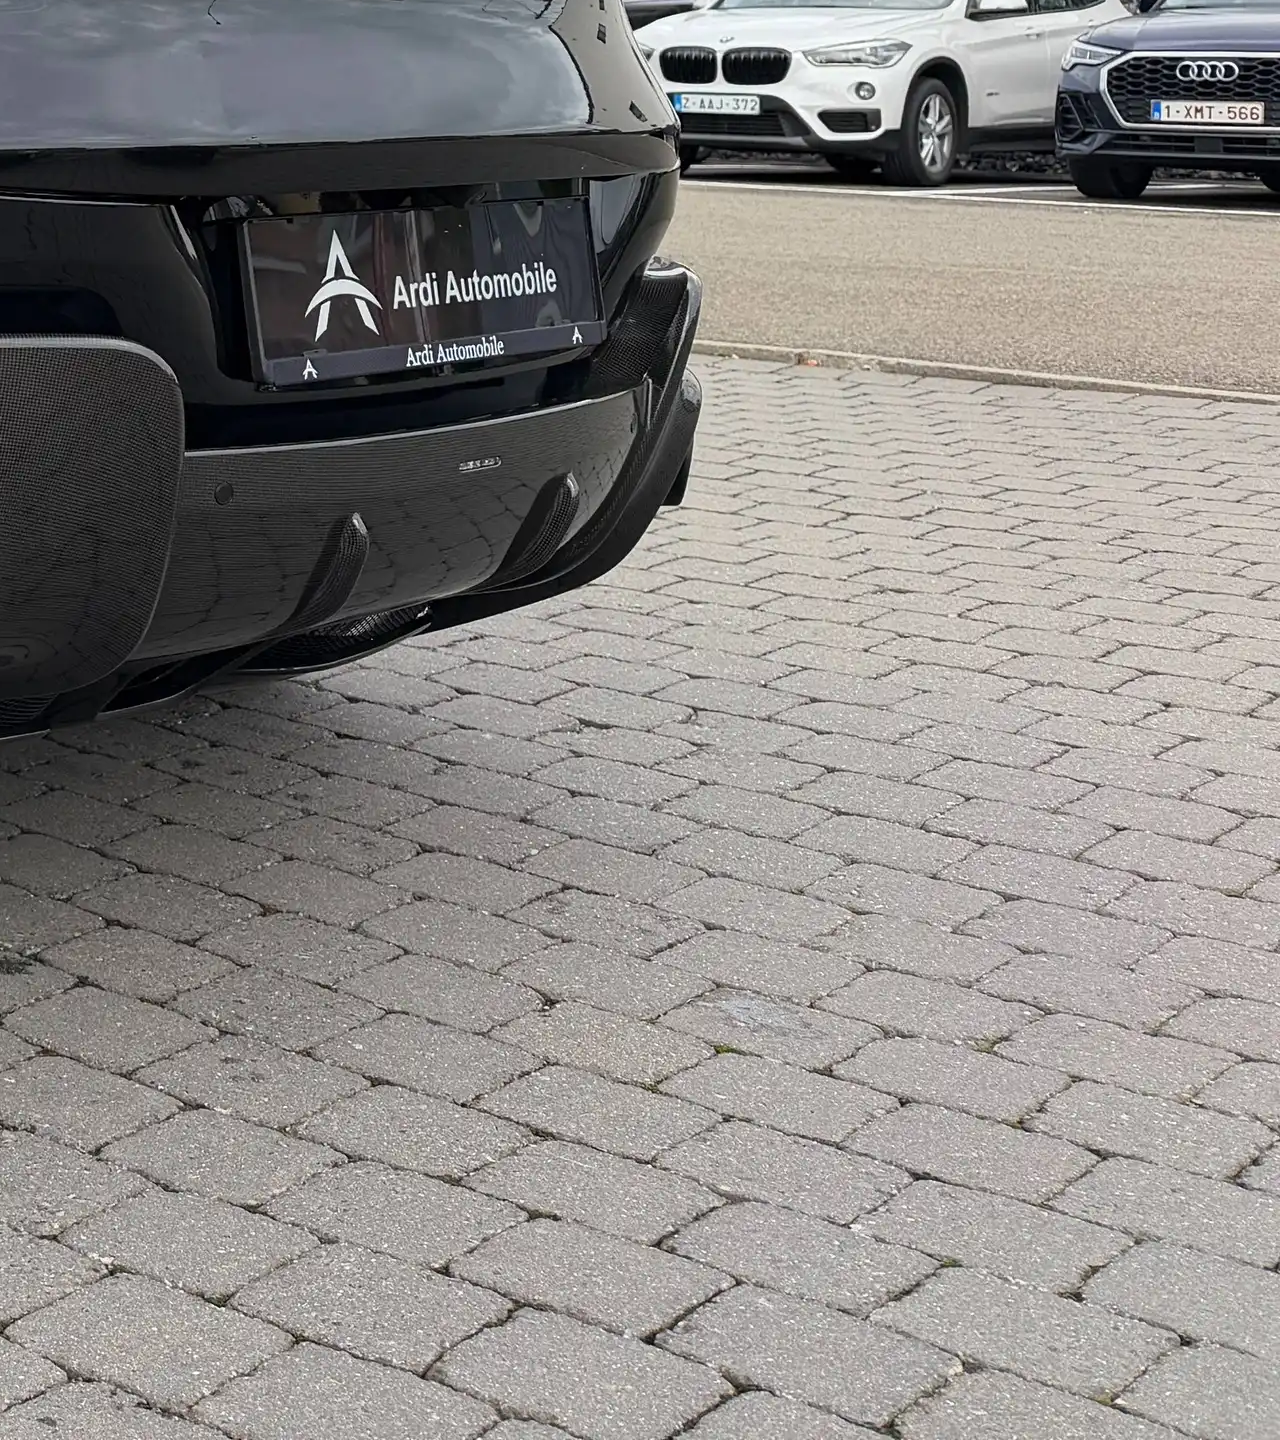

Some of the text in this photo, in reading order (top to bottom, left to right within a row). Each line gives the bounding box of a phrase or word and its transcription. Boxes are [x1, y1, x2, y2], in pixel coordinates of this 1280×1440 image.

[1164, 104, 1260, 121] 1-XMT-566
[393, 261, 557, 310] Ardi Automobile
[405, 335, 505, 368] Ardi Automobile
